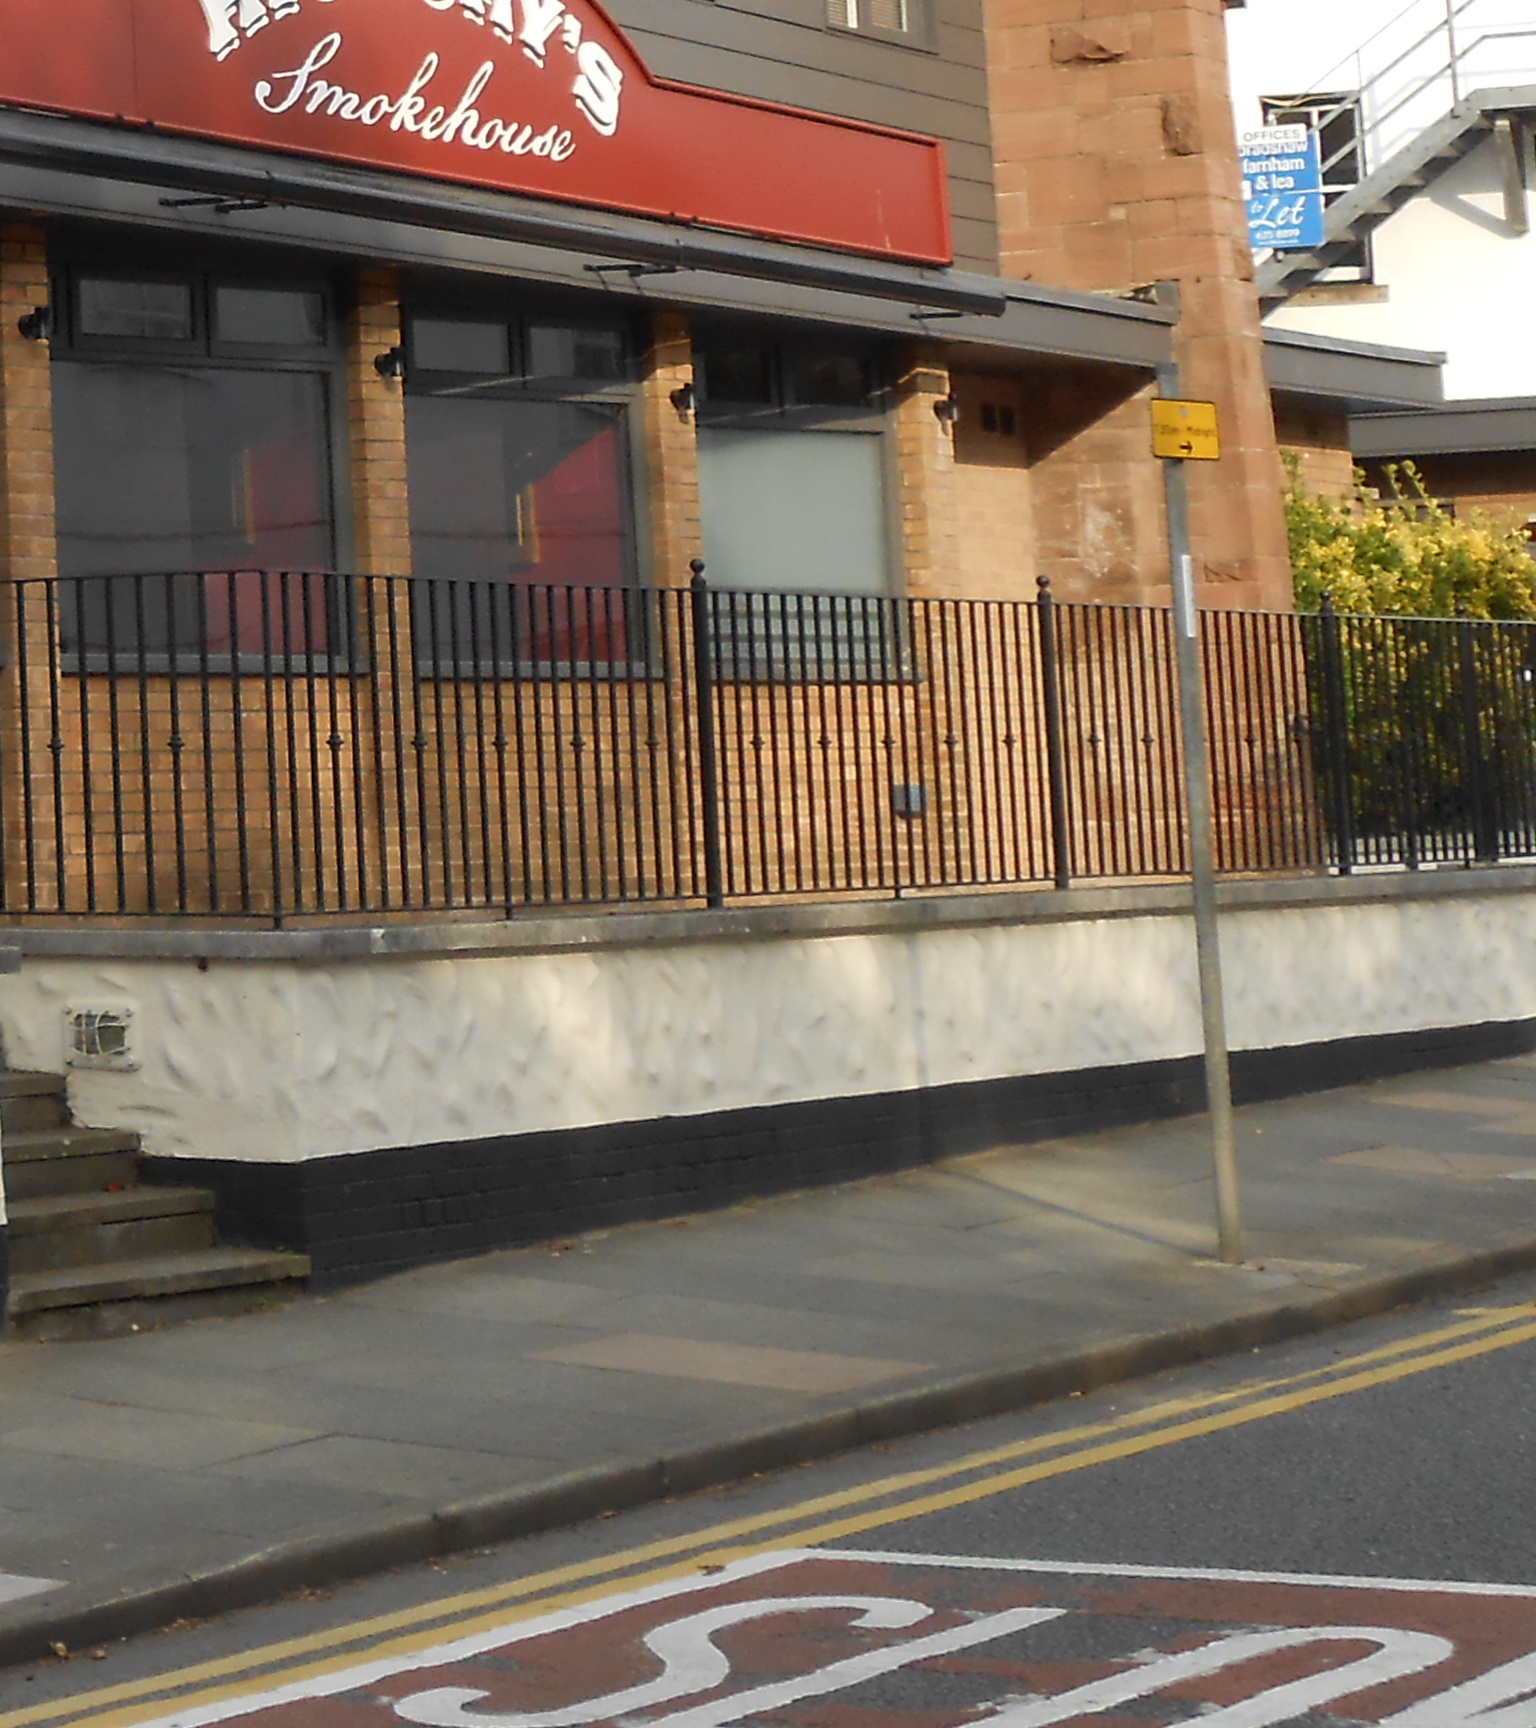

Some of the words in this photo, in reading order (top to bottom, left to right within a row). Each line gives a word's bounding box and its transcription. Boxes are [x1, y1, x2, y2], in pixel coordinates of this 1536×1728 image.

[254, 31, 577, 162] Smokehouse
[1243, 129, 1300, 142] OFFICES
[1255, 176, 1270, 191] &
[1248, 195, 1306, 228] Let
[394, 1595, 1536, 1728] SLO
